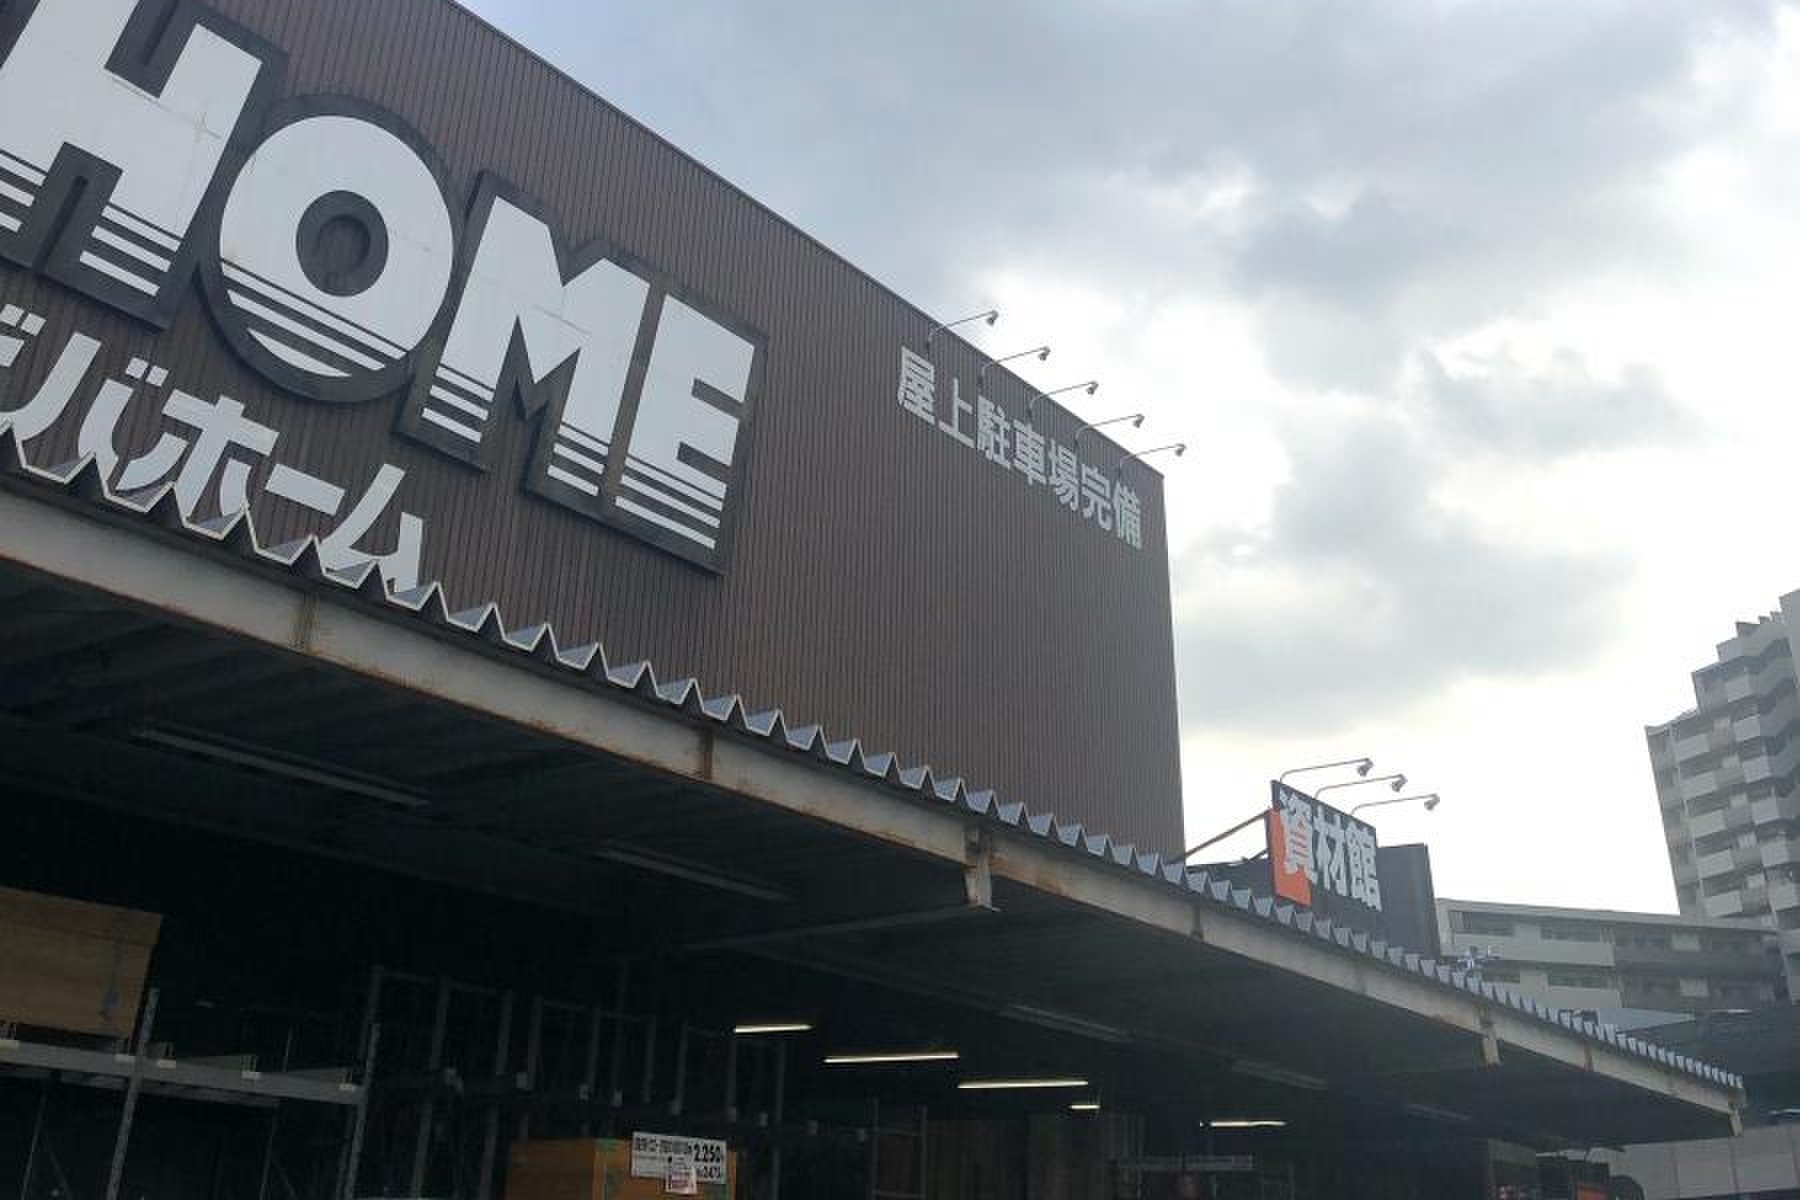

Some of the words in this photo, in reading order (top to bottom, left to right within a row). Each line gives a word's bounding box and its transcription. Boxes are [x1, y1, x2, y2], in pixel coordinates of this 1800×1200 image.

[897, 345, 1142, 550] 屋上駐車場完備
[1279, 786, 1382, 912] 資材館
